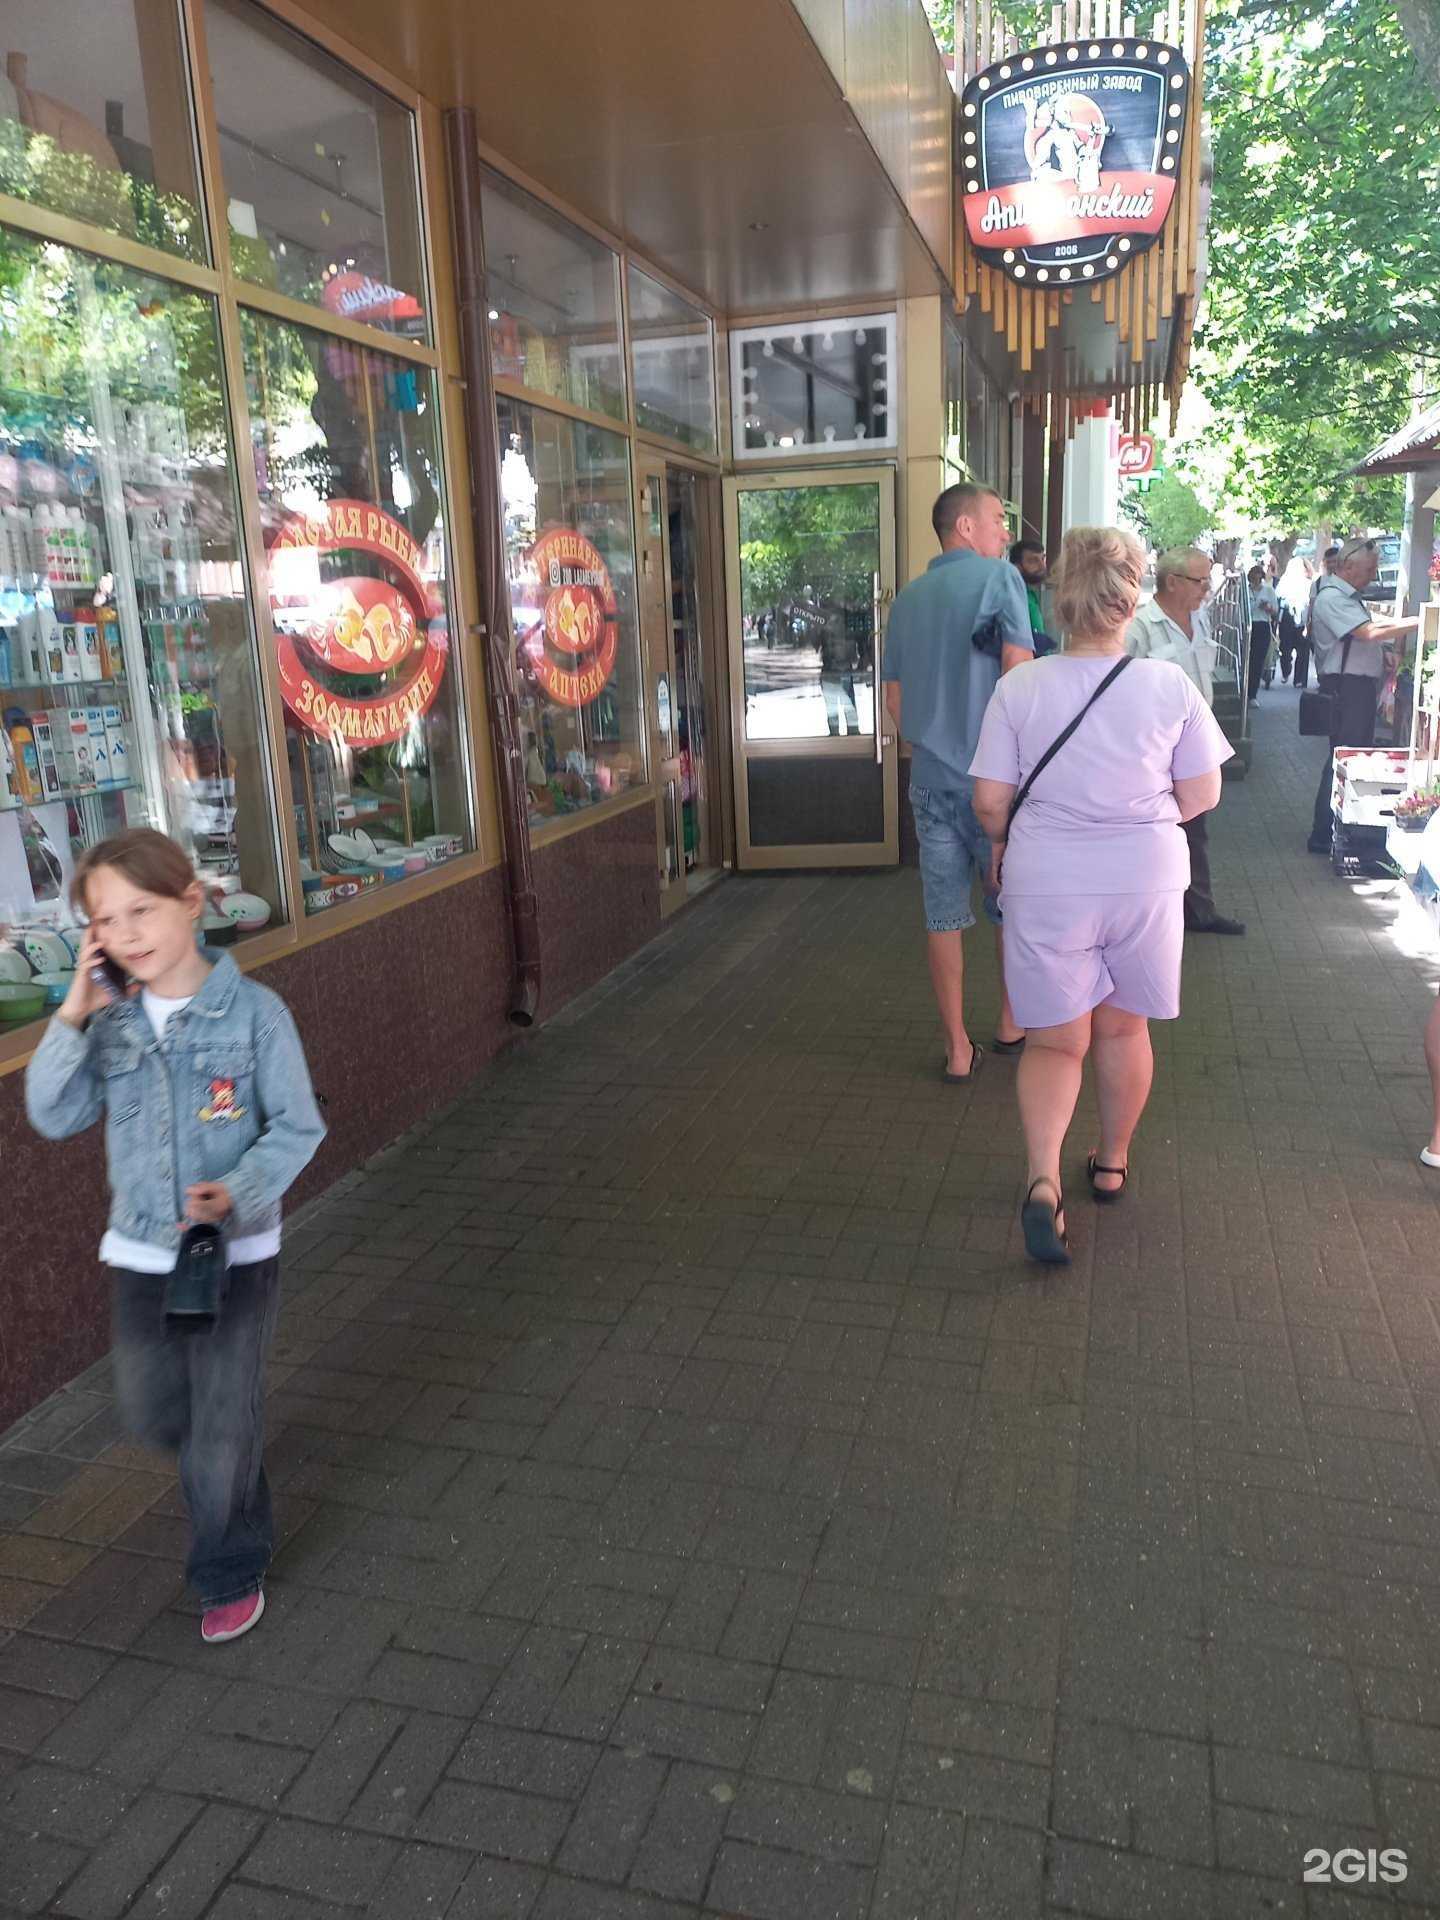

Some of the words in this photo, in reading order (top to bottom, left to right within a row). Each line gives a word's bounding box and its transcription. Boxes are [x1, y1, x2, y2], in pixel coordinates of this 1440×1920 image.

[1002, 74, 1100, 109] ПИВОВАРЕННЫЙ
[1102, 75, 1143, 93] ЗАВОД
[549, 661, 605, 699] АПТЕКА
[295, 666, 434, 739] ЗООМАГАЗИН
